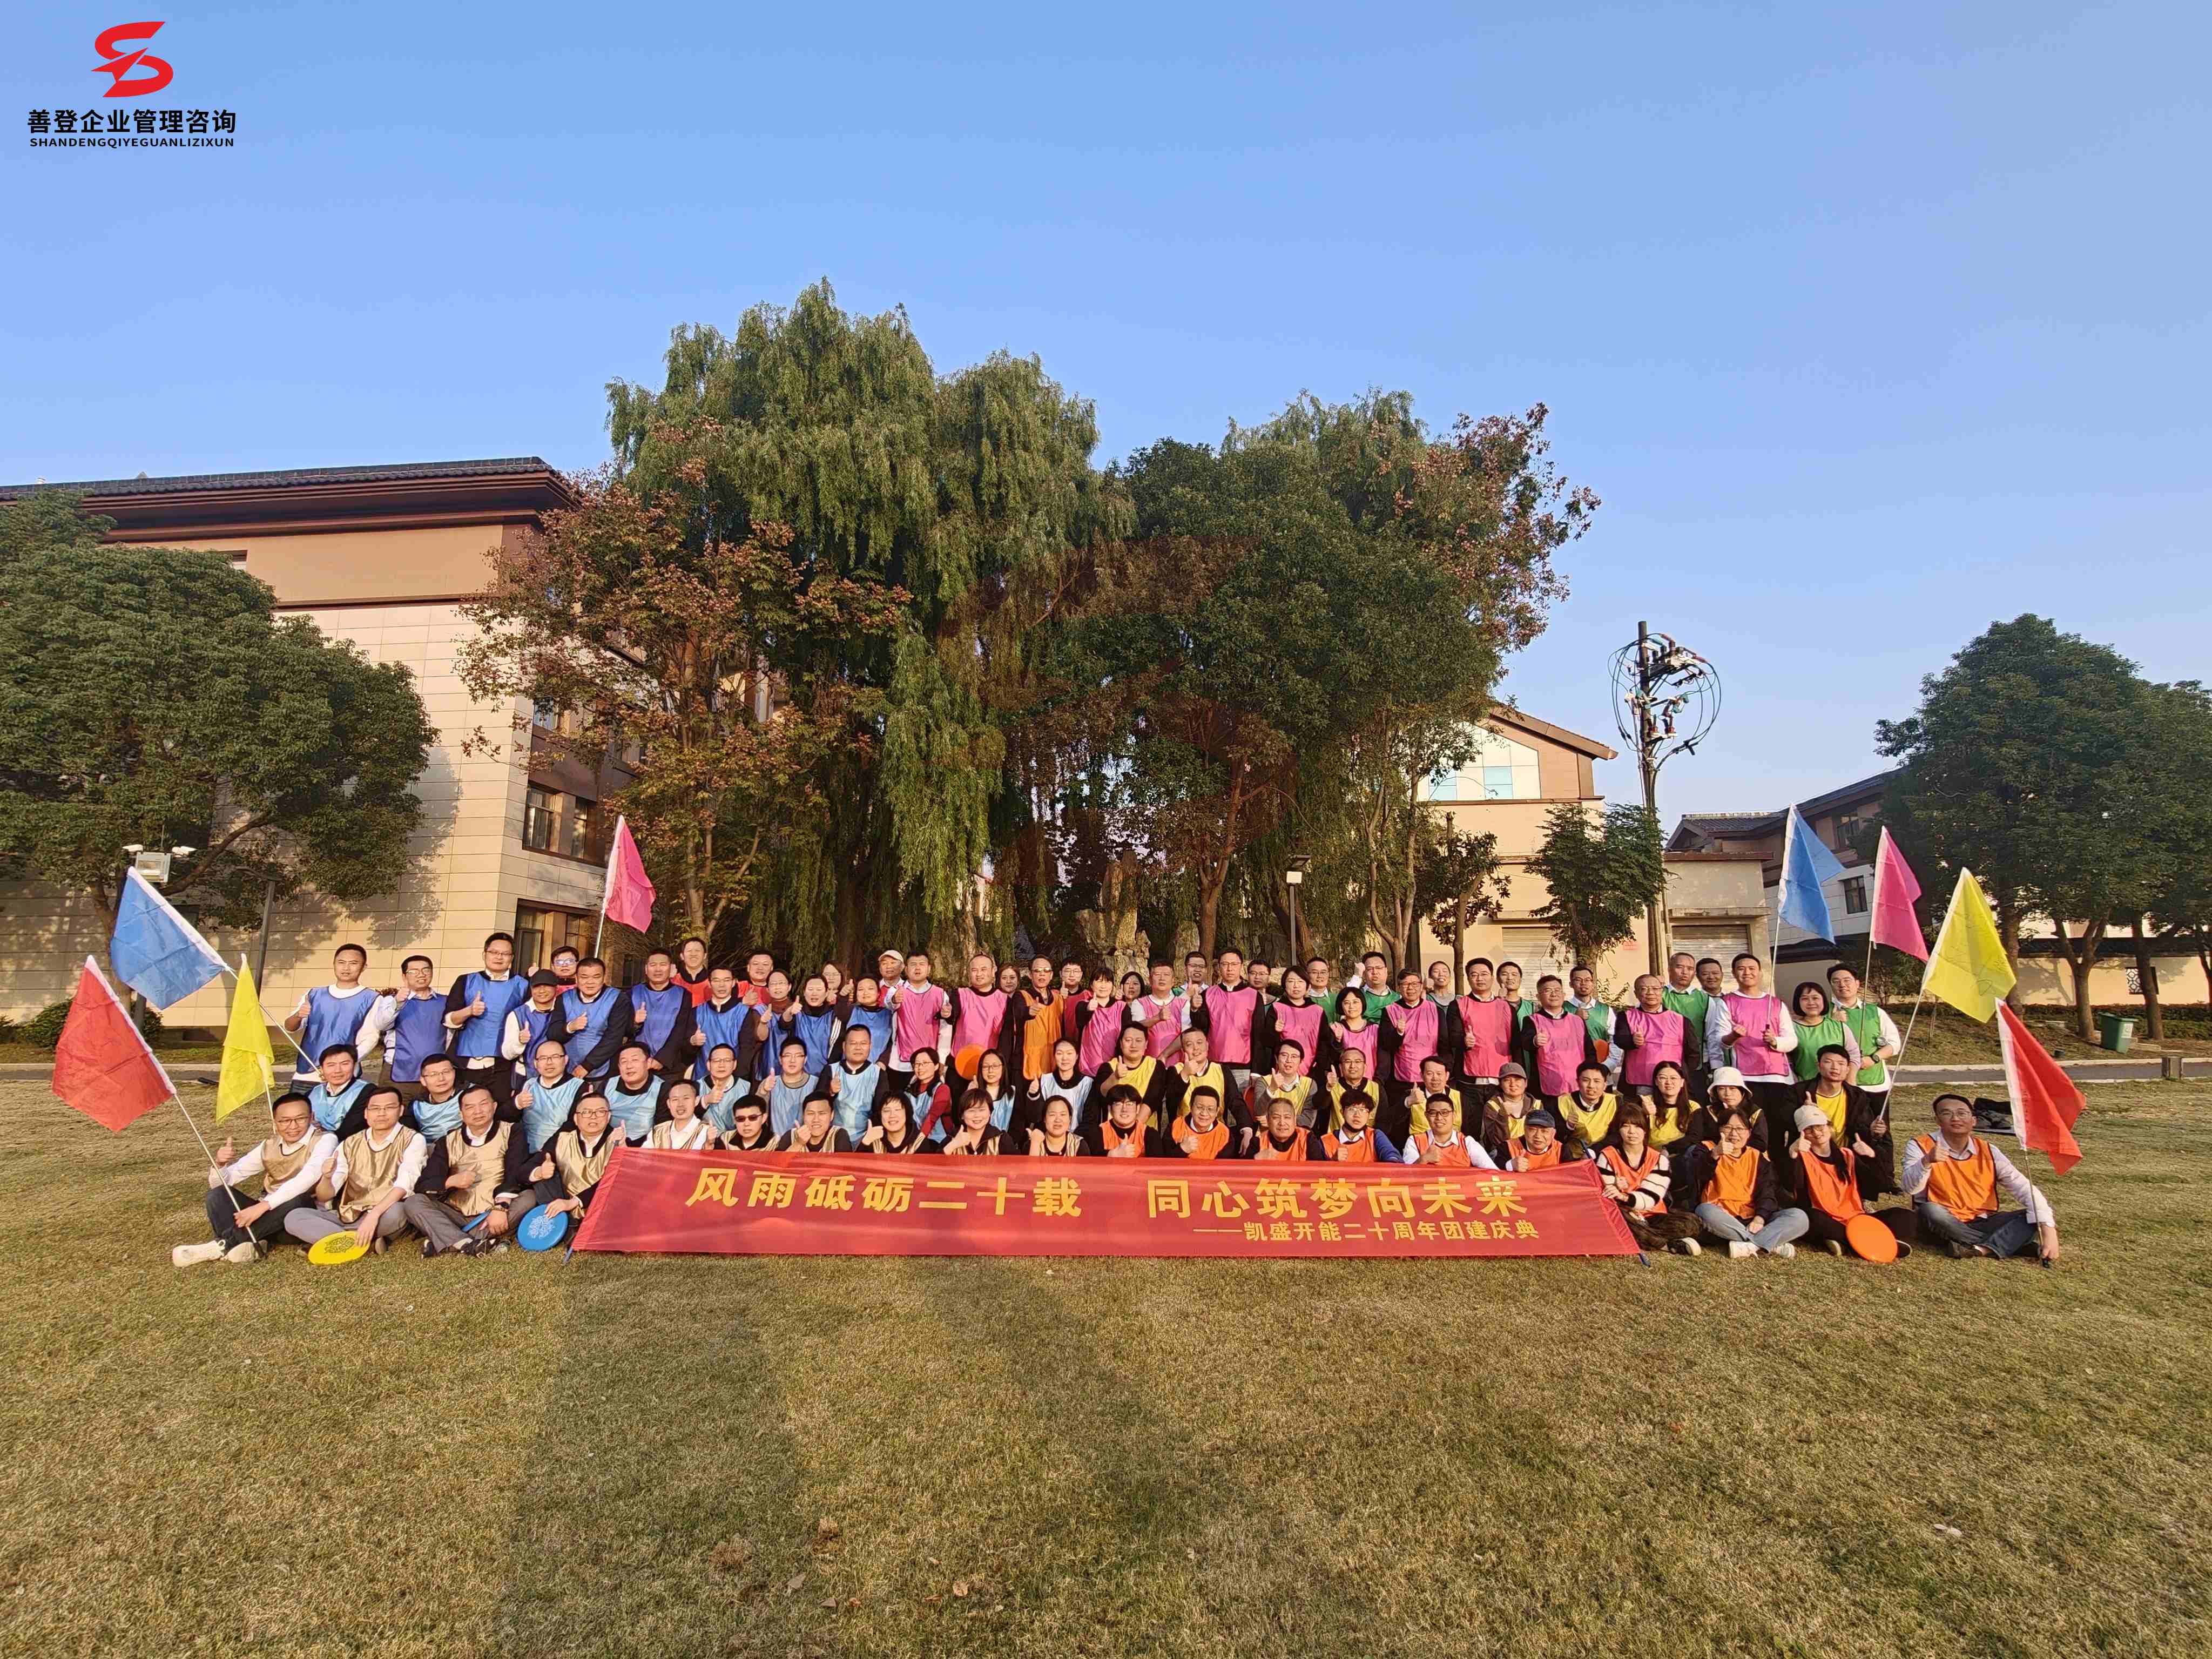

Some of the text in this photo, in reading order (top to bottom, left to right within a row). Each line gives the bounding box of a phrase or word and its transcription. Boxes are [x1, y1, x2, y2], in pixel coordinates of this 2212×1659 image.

[686, 1168, 1528, 1219] 风雨砥砺二十载 同心筑梦向未来
